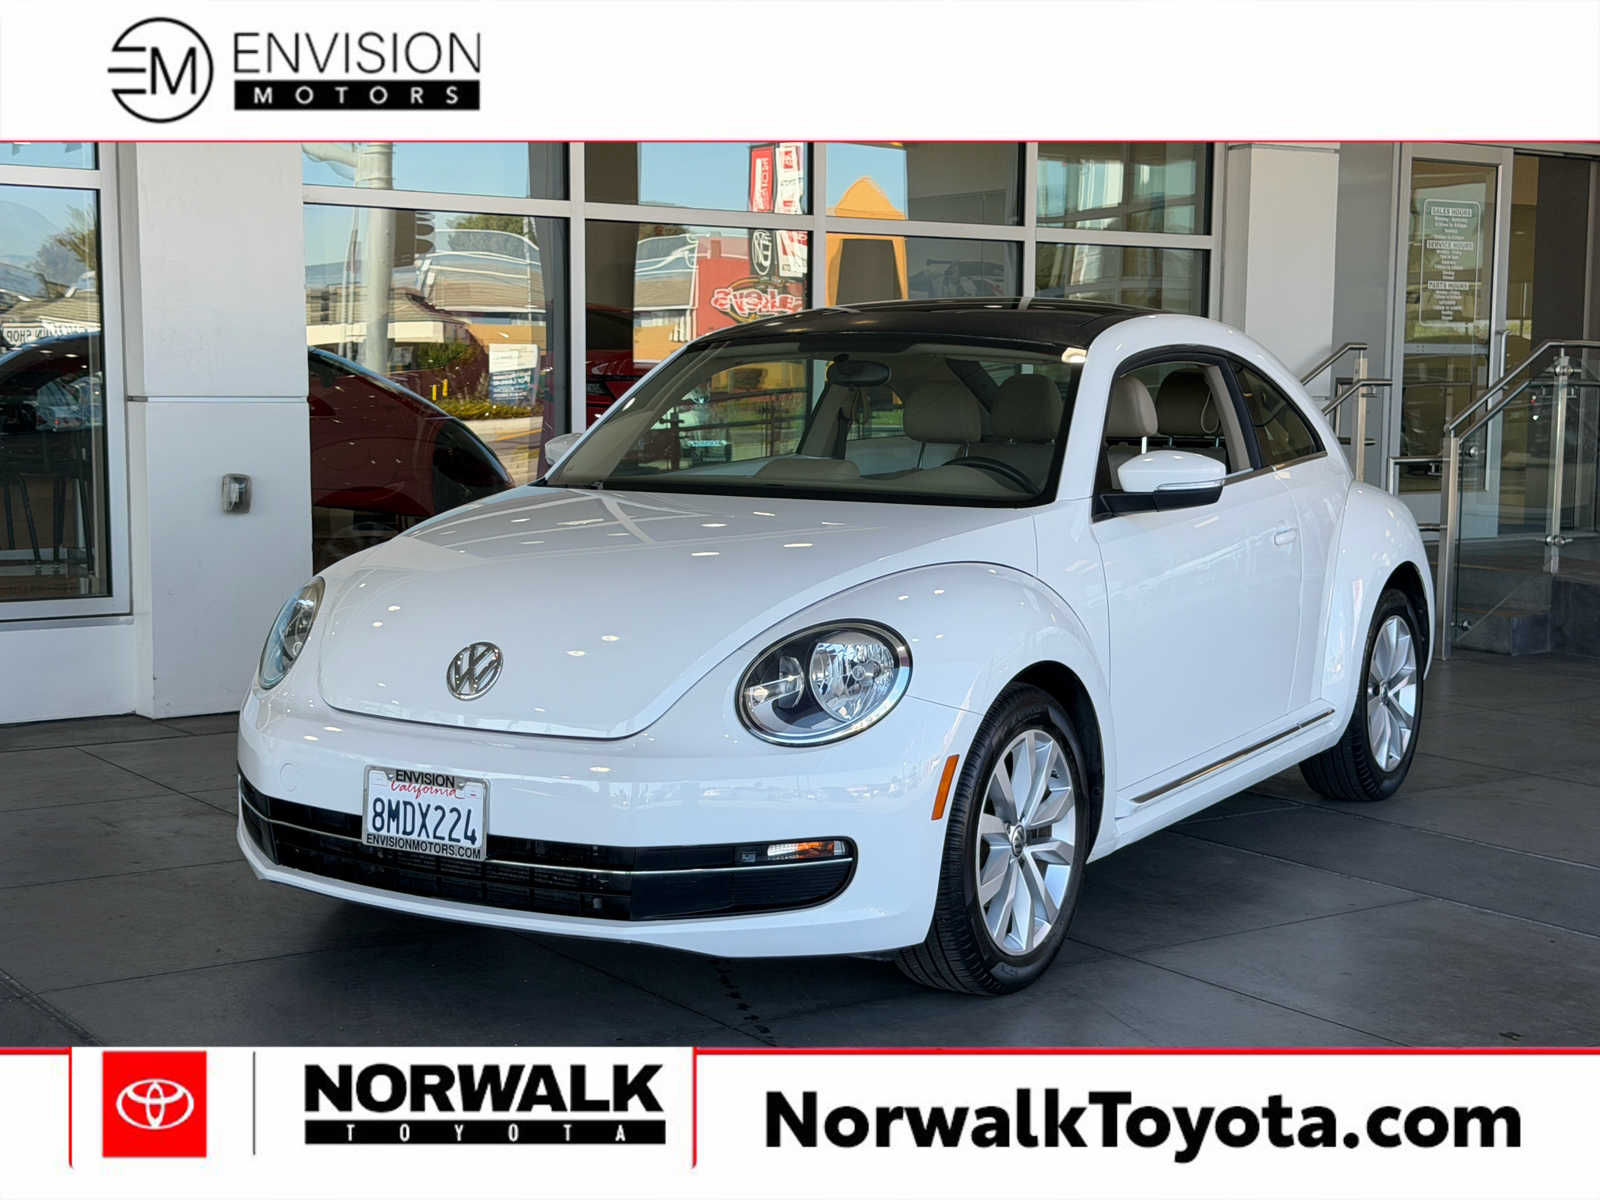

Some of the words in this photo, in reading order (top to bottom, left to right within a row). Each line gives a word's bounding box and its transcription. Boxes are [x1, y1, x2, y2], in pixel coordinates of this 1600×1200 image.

[395, 769, 456, 788] ENVISION
[372, 797, 478, 845] 8MDX224
[366, 833, 481, 859] ENVISIONMOTORS.COM
